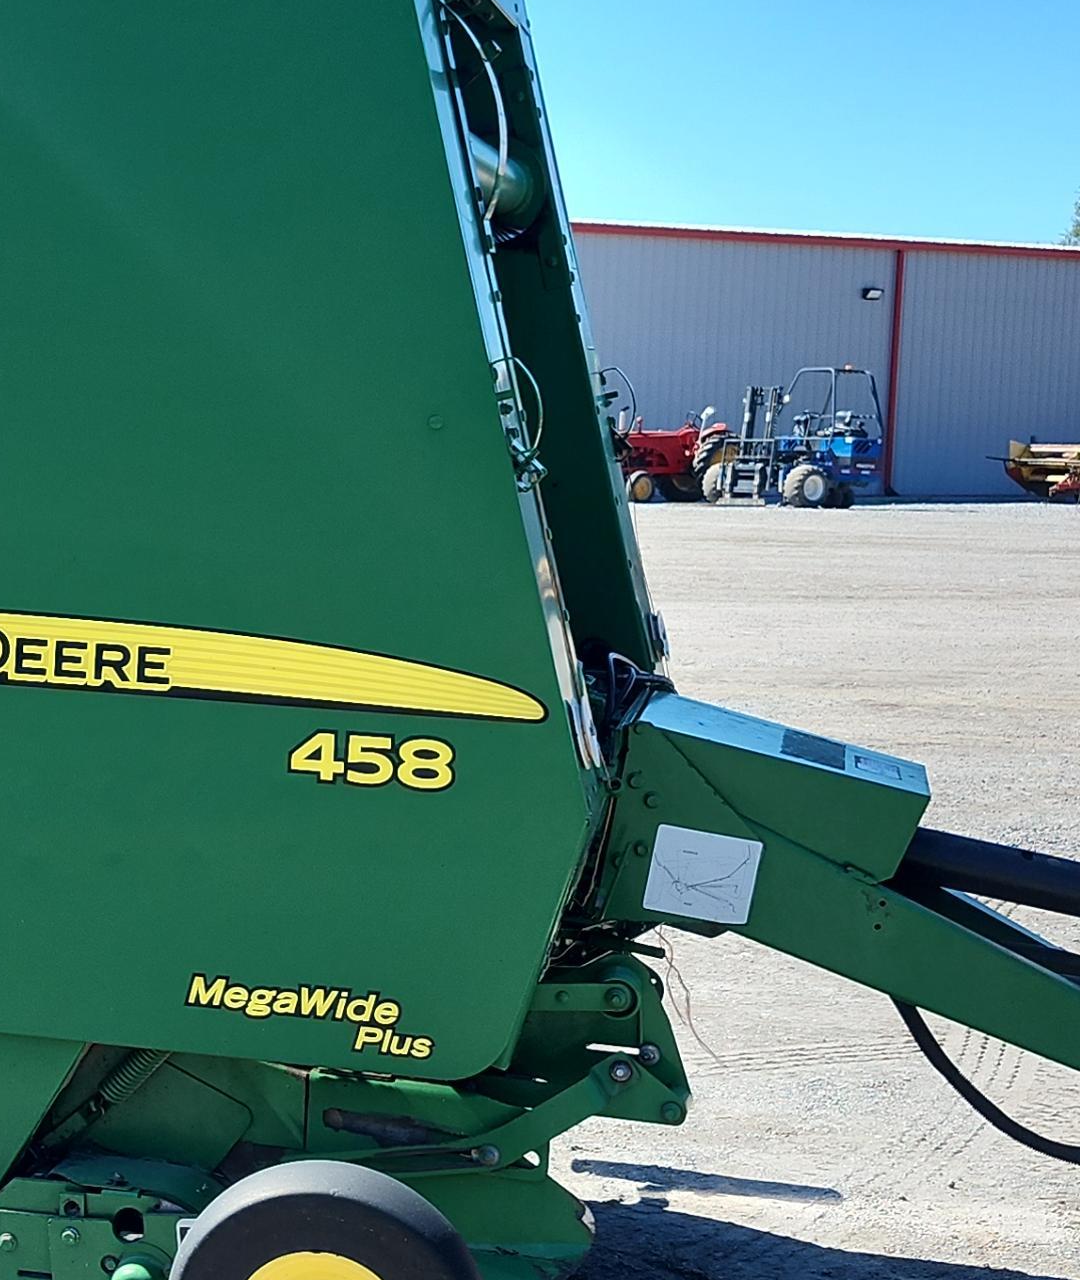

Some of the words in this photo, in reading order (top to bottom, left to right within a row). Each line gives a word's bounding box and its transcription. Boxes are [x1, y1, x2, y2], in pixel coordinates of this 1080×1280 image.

[290, 732, 454, 790] 458
[187, 975, 399, 1025] MegaWide
[354, 1025, 433, 1058] Plus
